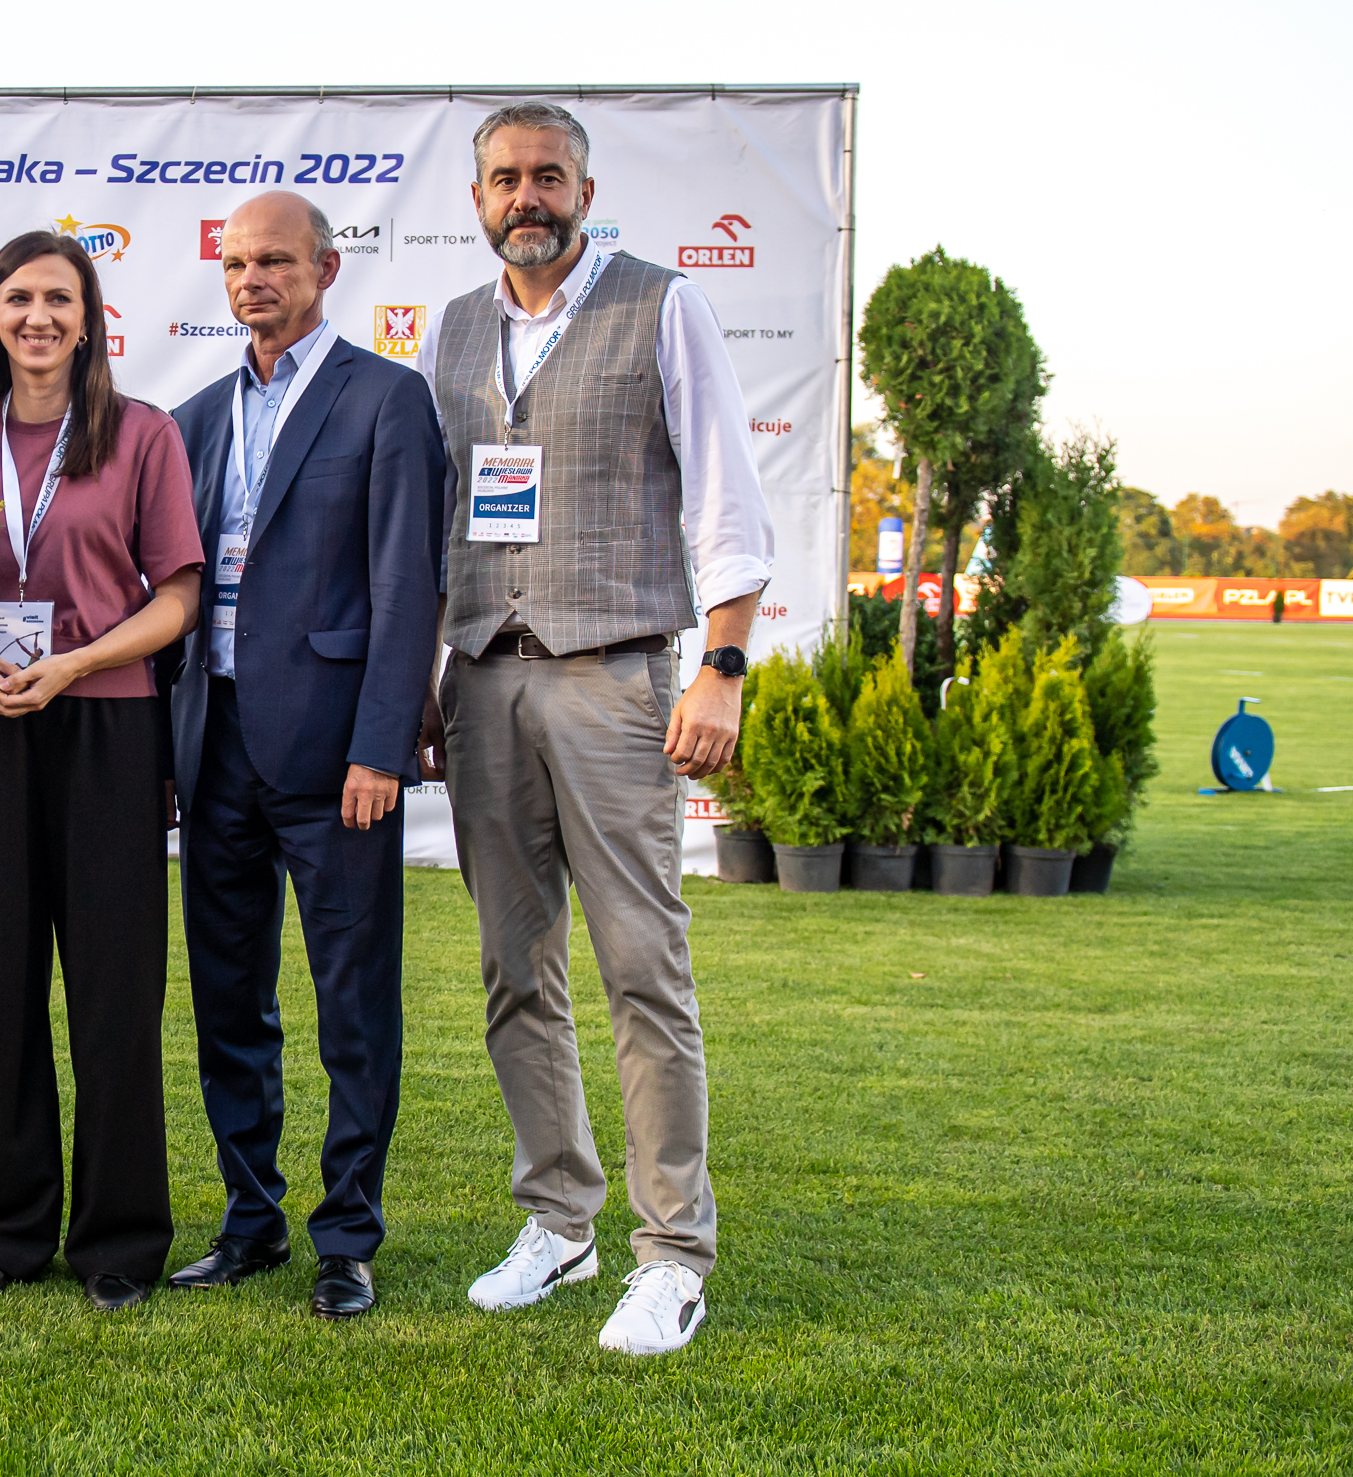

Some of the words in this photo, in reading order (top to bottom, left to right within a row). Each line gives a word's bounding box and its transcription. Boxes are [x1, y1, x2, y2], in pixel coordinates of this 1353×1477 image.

[106, 153, 285, 184] Szczecin
[293, 153, 405, 184] 2022
[77, 231, 115, 253] OTTO
[403, 235, 442, 245] SPORT
[443, 235, 457, 245] TO
[459, 235, 477, 245] MY
[681, 249, 751, 265] ORLEN
[565, 292, 586, 320] GRUPA
[169, 322, 249, 337] #Szczecin
[759, 329, 774, 339] TO
[777, 329, 794, 339] MY
[377, 341, 419, 356] PZLA
[529, 330, 562, 374] POLMOTOR
[478, 503, 530, 512] ORGANIZER
[685, 801, 726, 817] RLE
